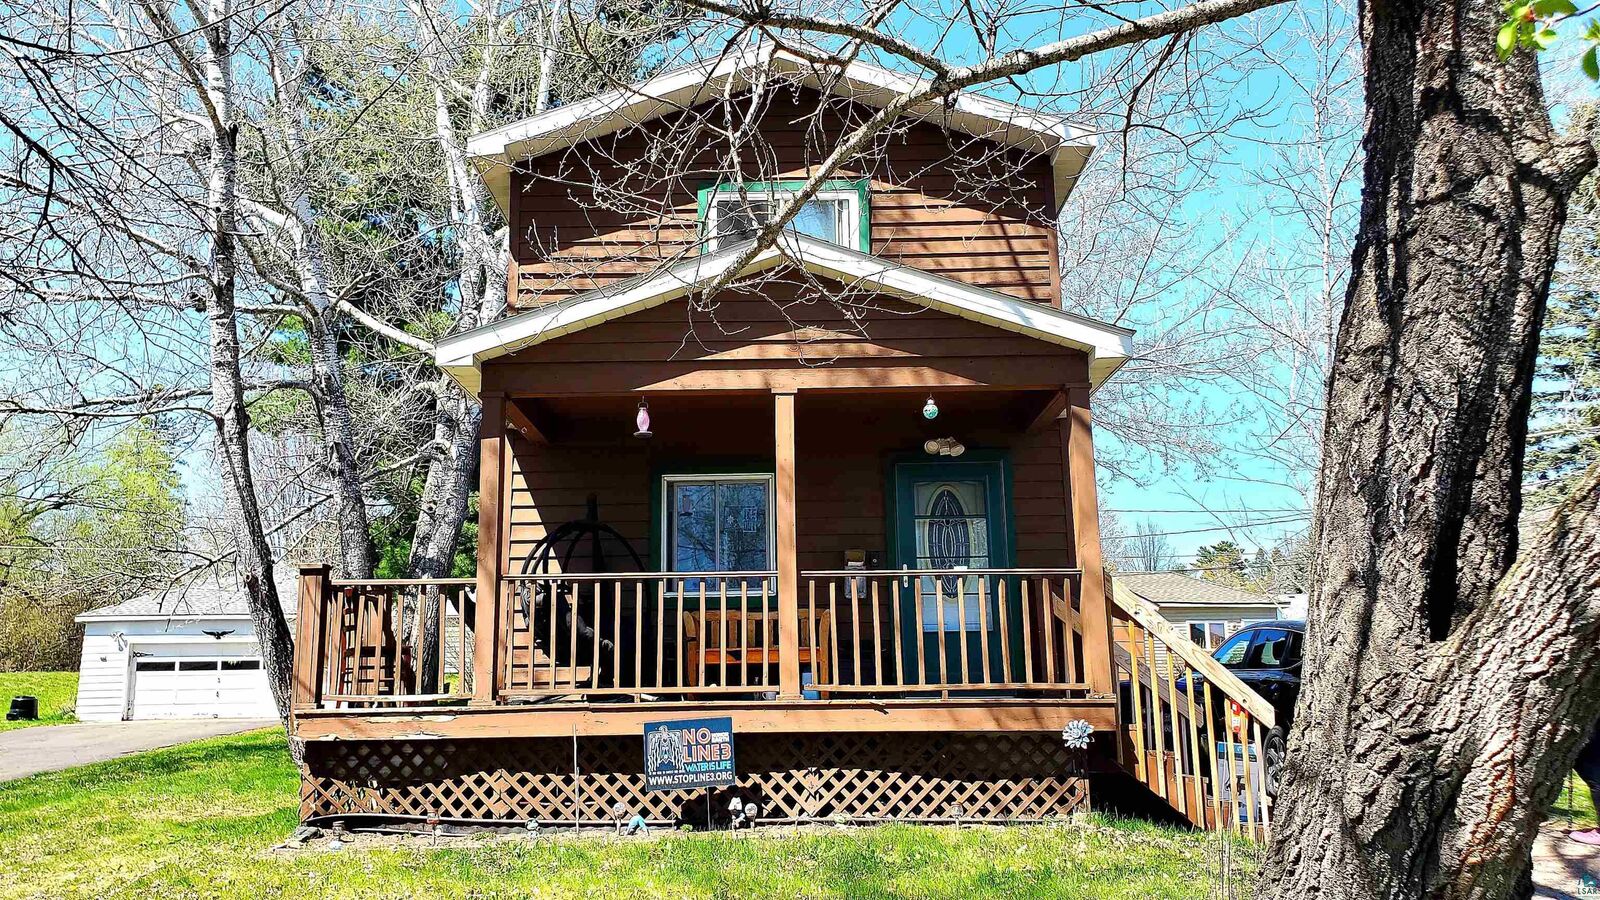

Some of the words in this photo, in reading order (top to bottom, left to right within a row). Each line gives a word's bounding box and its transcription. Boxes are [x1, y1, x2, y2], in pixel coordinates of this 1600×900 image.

[683, 728, 711, 745] NO
[684, 763, 709, 772] WATER
[716, 761, 731, 770] LIFE
[648, 772, 732, 785] WWW.STOPLINE3.ORG
